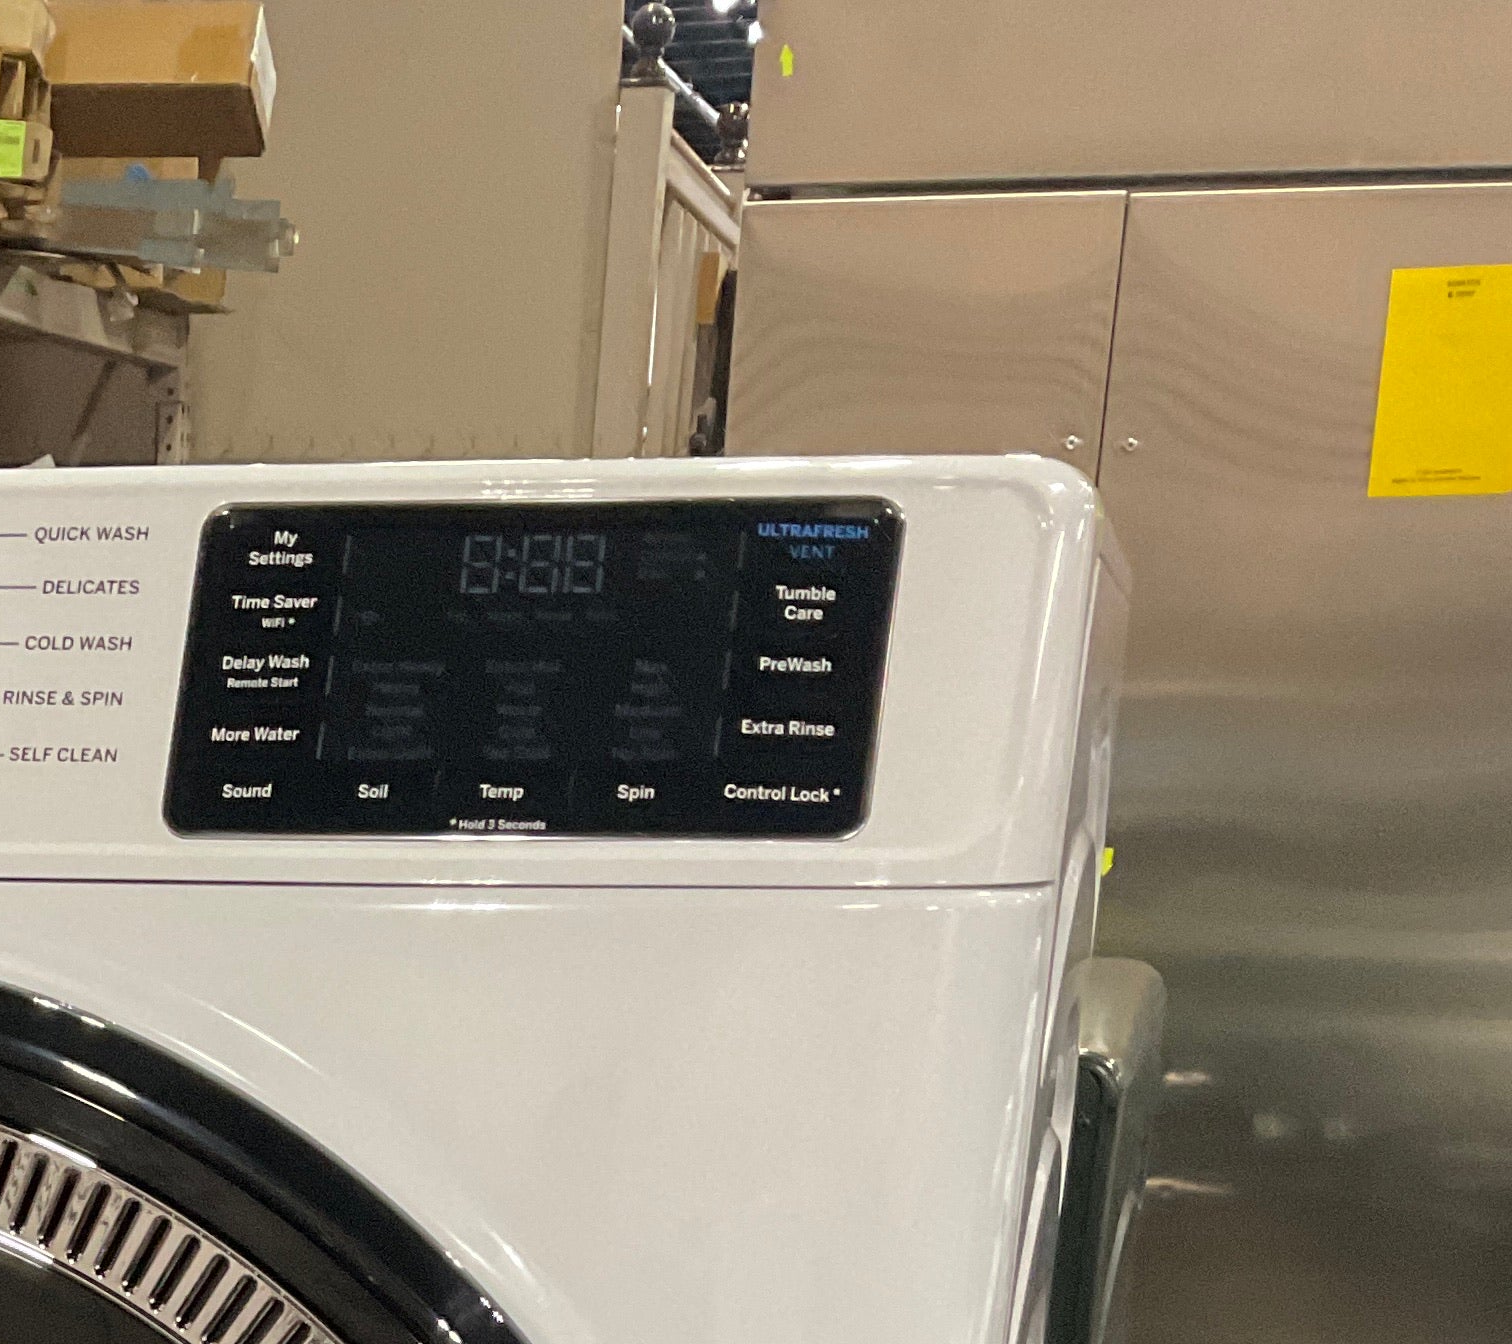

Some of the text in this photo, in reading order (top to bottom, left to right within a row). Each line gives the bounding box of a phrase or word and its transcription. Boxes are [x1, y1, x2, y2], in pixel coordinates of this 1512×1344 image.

[34, 526, 150, 544] QUICK WASH
[274, 530, 298, 547] My
[758, 522, 869, 539] ULTRAFRESH
[248, 551, 314, 568] Settings
[789, 545, 836, 560] VENT
[42, 580, 140, 595] DELICATES
[775, 585, 837, 601] Tumble
[232, 594, 318, 609] Time Saver
[784, 605, 824, 620] Care
[25, 635, 133, 651] COLD WASH
[222, 654, 310, 672] Delay Wash
[759, 656, 832, 672] PreWash
[227, 677, 298, 689] Remote Start
[2, 690, 124, 707] RINSE & SPIN
[211, 726, 300, 742] More Water
[741, 719, 835, 736] Extra Rinse
[9, 747, 118, 763] SELF CLEAN
[222, 783, 273, 799] Sound
[358, 784, 389, 799] Soil
[479, 784, 525, 801] Temp
[617, 784, 656, 803] Spin
[724, 783, 830, 803] Control Lock
[458, 818, 547, 830] Hold 3 Seconds
